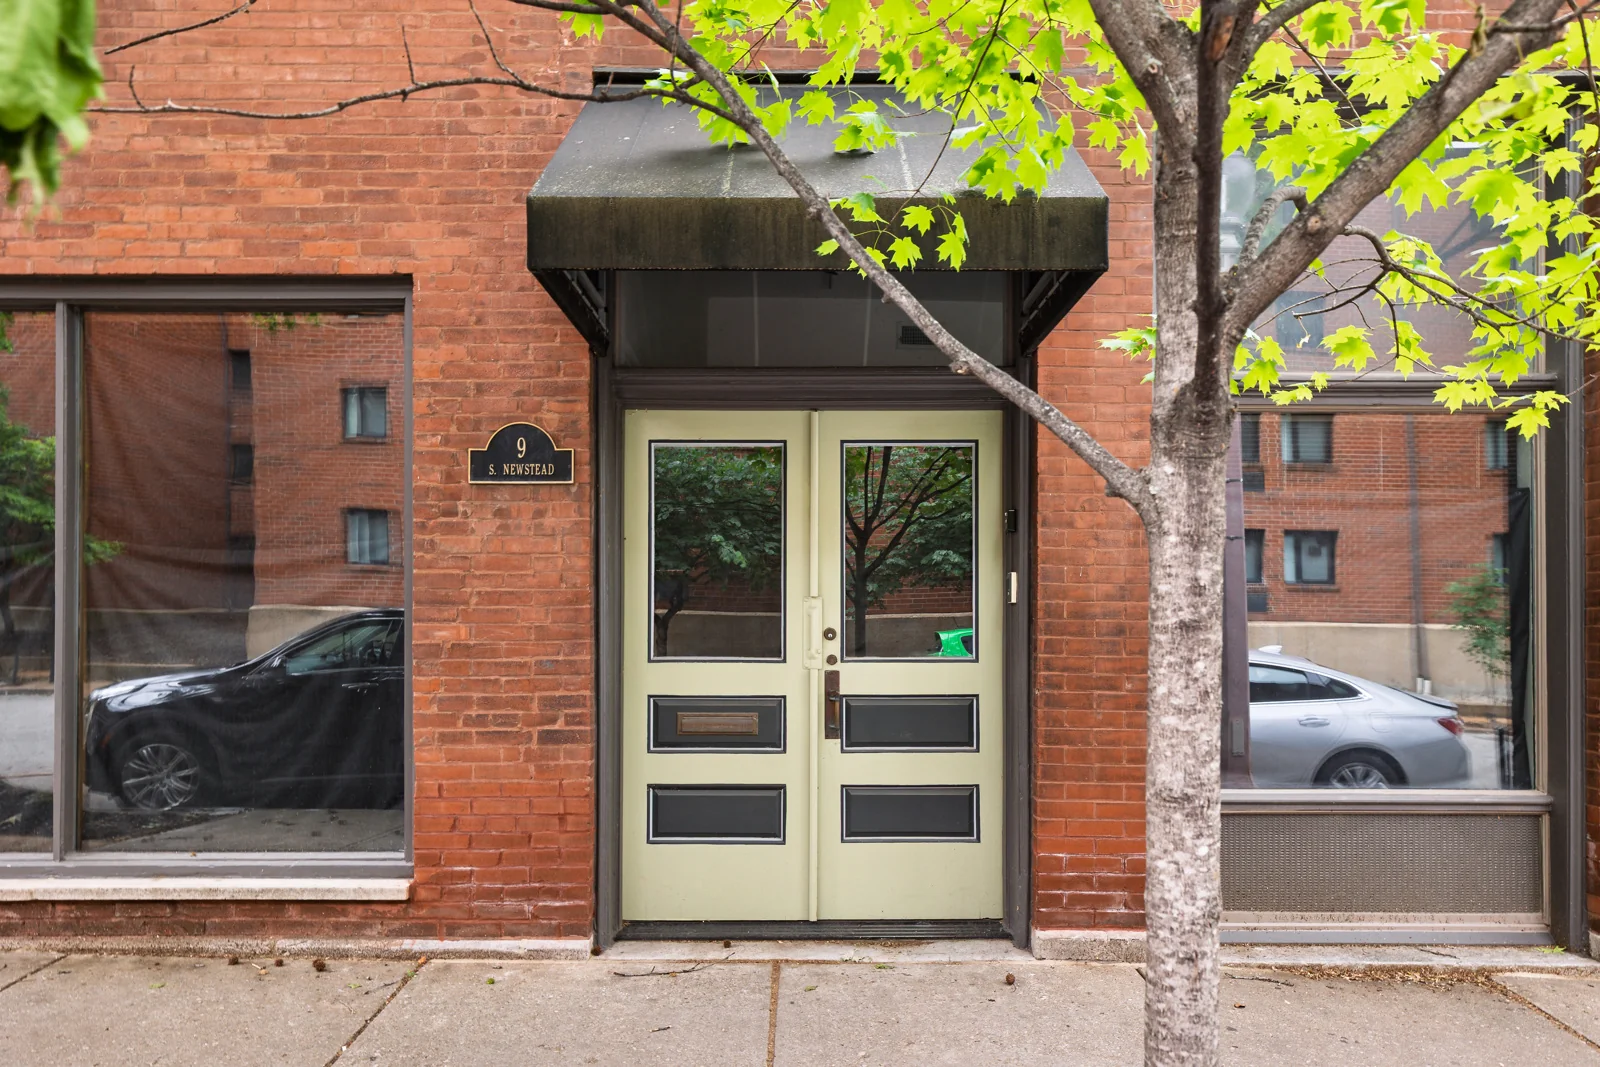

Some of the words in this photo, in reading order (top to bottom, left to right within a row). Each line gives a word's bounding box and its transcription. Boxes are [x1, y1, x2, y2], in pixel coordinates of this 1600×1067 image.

[516, 437, 527, 458] 9
[488, 463, 497, 476] S.
[502, 463, 555, 476] NEWSTEAD
